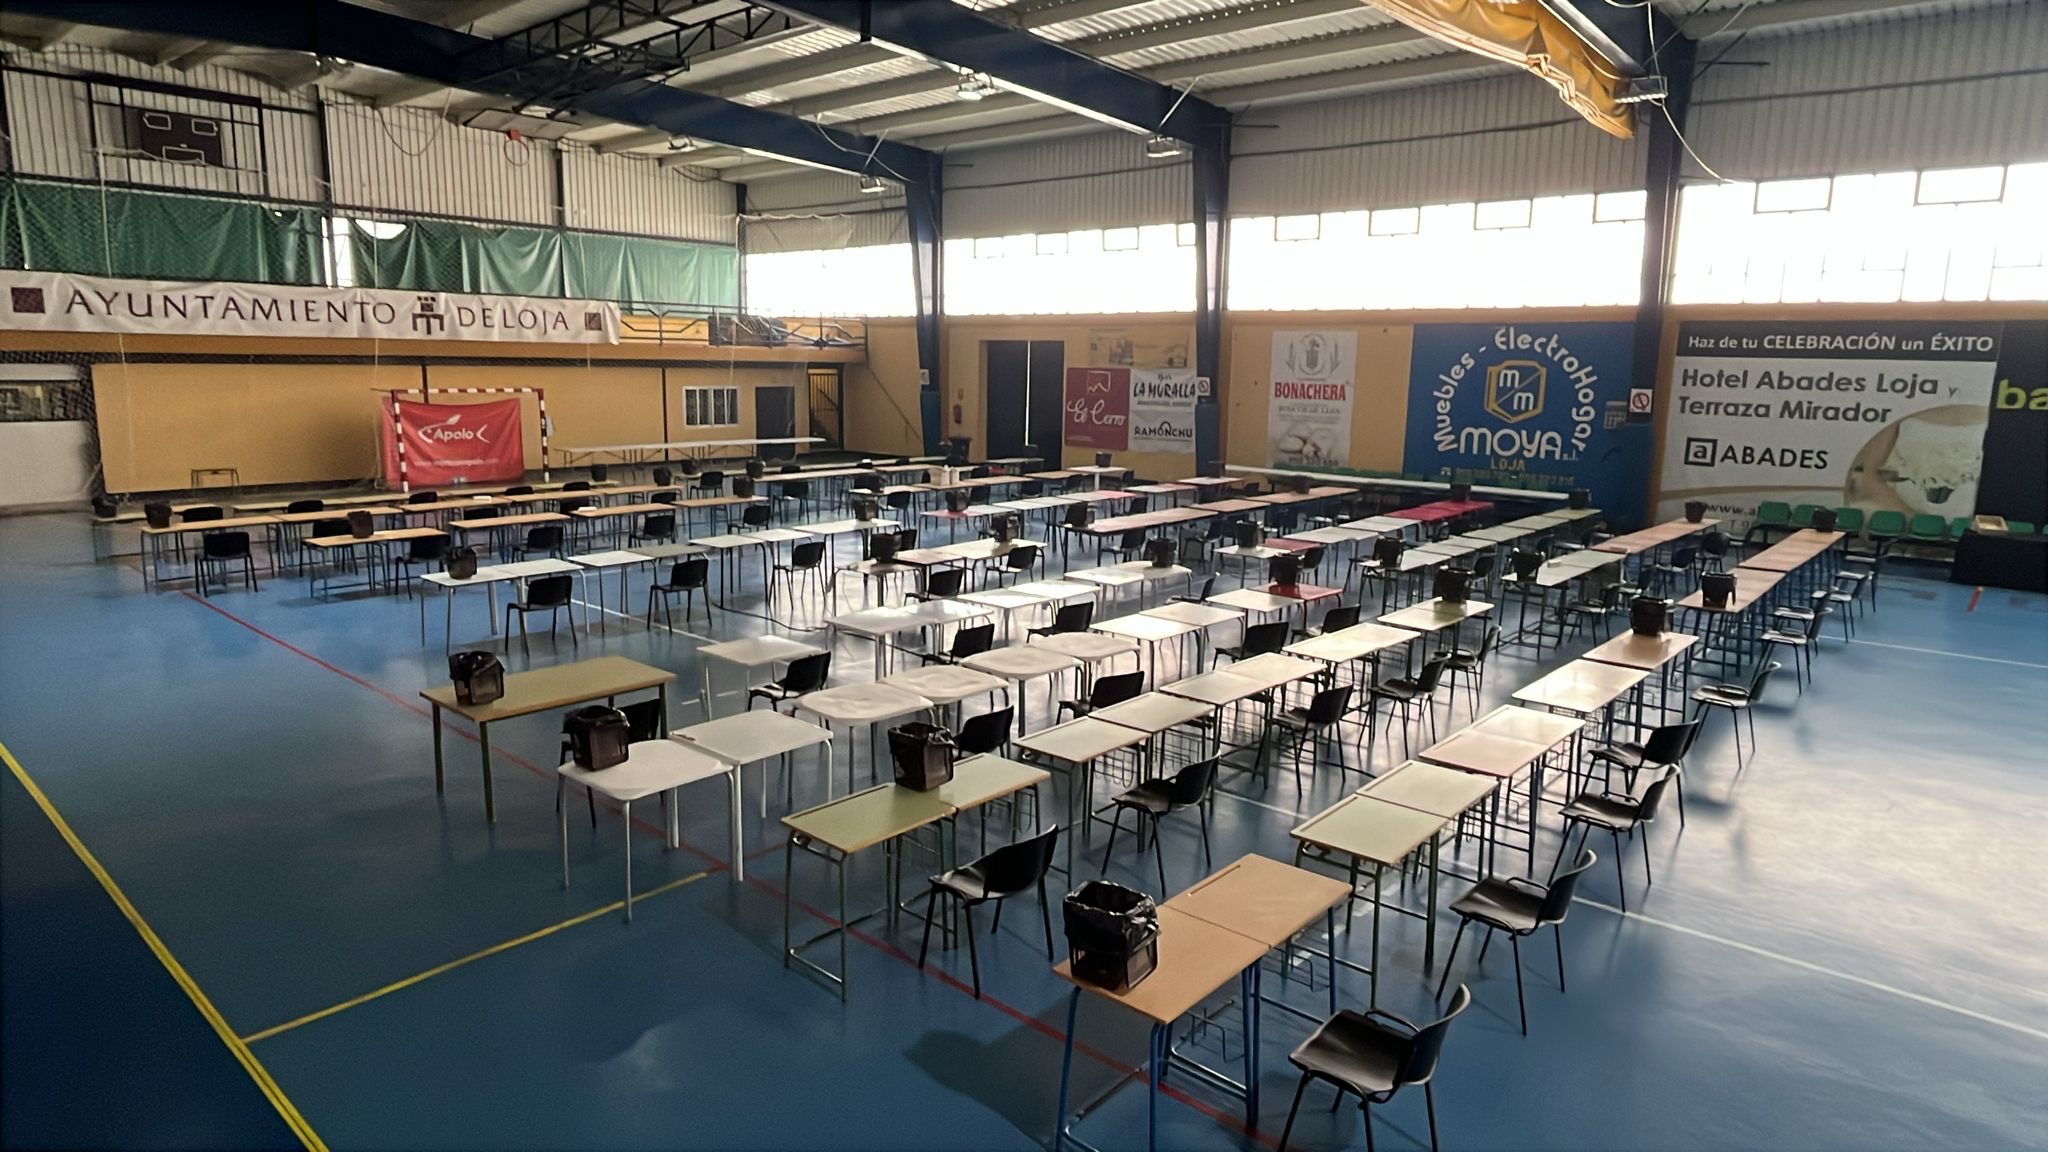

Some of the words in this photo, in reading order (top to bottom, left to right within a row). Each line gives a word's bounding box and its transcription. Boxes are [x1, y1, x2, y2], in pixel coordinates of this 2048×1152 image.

[65, 287, 396, 325] AYUNTAMIENTO
[1688, 336, 1715, 348] Haz
[1719, 336, 1738, 348] de
[1742, 337, 1758, 348] tu
[1763, 332, 1896, 350] CELEBRACIÓN
[1901, 340, 1924, 350] un
[1931, 332, 1994, 351] ÉXITO
[1133, 382, 1146, 398] LA
[1148, 382, 1196, 399] MURALLA
[1274, 382, 1346, 401] BONACHERA
[1682, 368, 1749, 388] Hotel
[1755, 370, 1867, 392] Abades
[1876, 373, 1938, 399] Loja
[1433, 352, 1475, 452] Muebles
[1678, 396, 1771, 418] Terraza
[1779, 400, 1892, 423] Mirador
[433, 428, 474, 442] Apolo
[1720, 445, 1829, 470] ABADES
